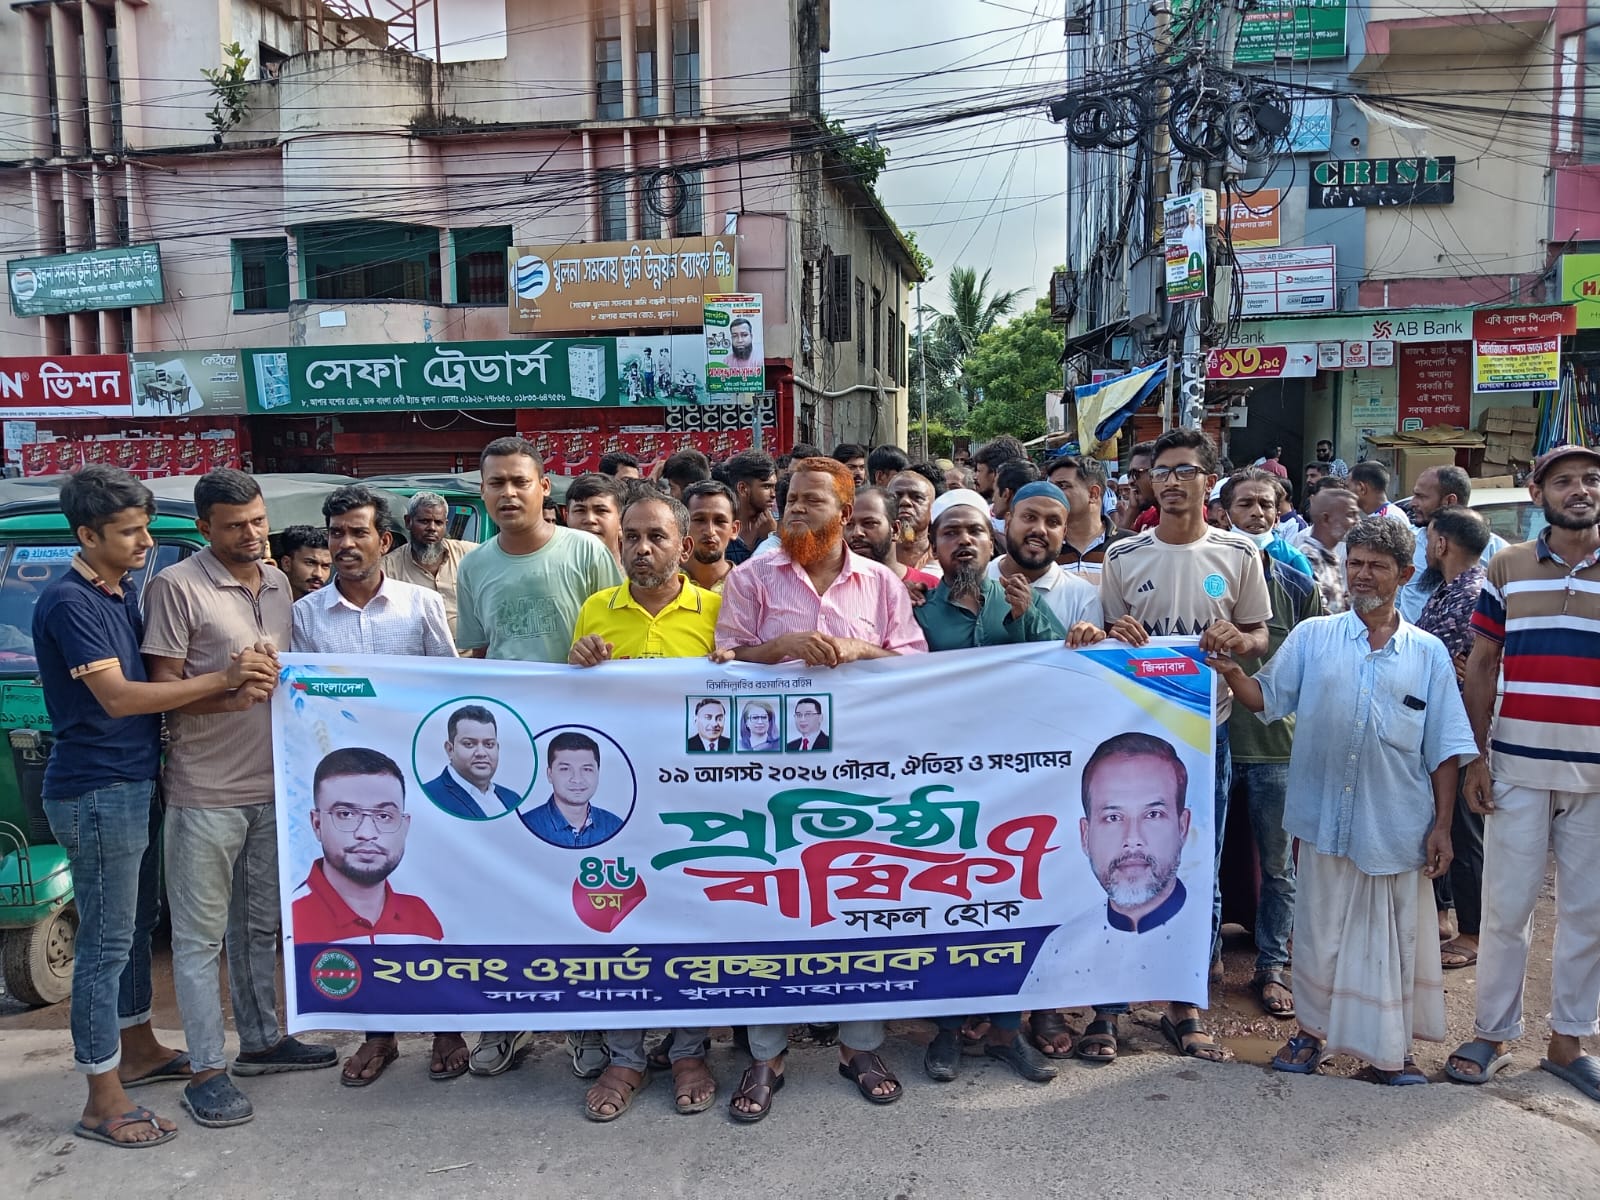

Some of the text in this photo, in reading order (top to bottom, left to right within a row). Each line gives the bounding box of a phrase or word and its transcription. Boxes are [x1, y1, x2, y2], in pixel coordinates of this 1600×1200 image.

[553, 240, 732, 294] খুলনা সমবায় ভূমি উন্নয়ন ব্যাংক লিঃ
[1485, 310, 1566, 326] এবি ব্যাংক পিএলসি.
[1395, 319, 1463, 336] AB Bank
[1229, 330, 1266, 346] Bank
[1543, 340, 1556, 352] হবে
[305, 341, 555, 392] সেফা ট্রেডার্স
[1415, 358, 1457, 368] পাসপোর্ট ফি
[38, 361, 122, 400] ভিশন
[1427, 370, 1453, 378] অন্যান্য
[1416, 380, 1454, 391] সরকারি ফি
[309, 397, 327, 407] আপার
[327, 396, 346, 407] যশোর
[346, 396, 362, 407] রোড,
[362, 396, 375, 406] ডাক
[375, 395, 392, 406] বাংলা
[1417, 393, 1453, 402] এই শাখায়
[1408, 403, 1462, 414] সরকার প্রবর্তিত
[1141, 660, 1187, 674] জিন্দাবাদ
[311, 680, 366, 696] বাংলাদেশ
[705, 676, 814, 692] বিসমিল্লাহির রহমানির রহিম
[658, 749, 1073, 784] ১৯ আগস্ট ২০২৬ গৌরব, ঐতিহ্য ও সংগ্রামের
[650, 784, 980, 872] প্রতিষ্ঠা
[578, 855, 637, 889] ৪৬
[682, 814, 1062, 928] বার্ষিকী
[586, 891, 623, 913] তম
[841, 899, 1024, 933] সফল হোক
[372, 940, 1027, 987] ২৩নং ওয়ার্ড স্বেচ্ছাসেবক দল
[481, 978, 919, 1004] সদর থানা, খুলনা মহানগর
